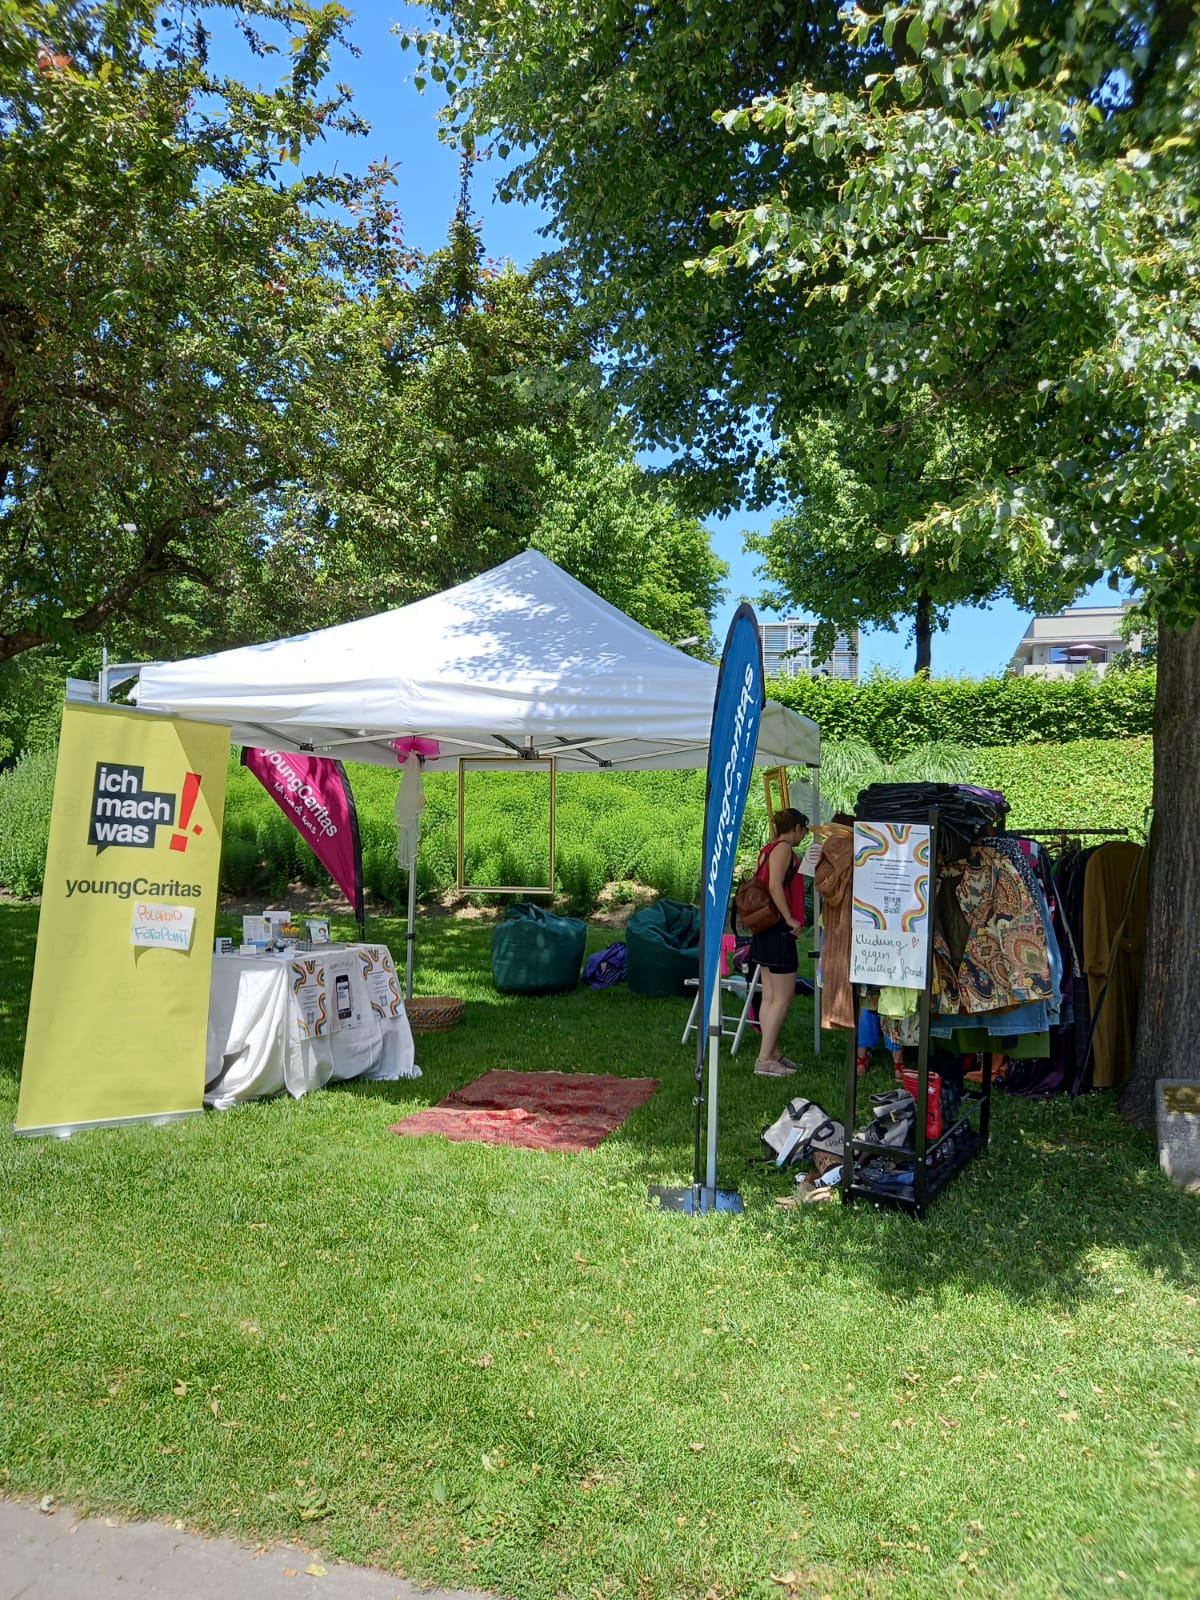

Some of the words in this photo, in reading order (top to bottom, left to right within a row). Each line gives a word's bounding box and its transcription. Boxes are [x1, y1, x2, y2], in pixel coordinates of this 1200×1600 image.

[99, 767, 138, 793] ich
[707, 663, 754, 905] youngCaritas
[260, 749, 338, 837] youngCaritas
[96, 797, 171, 821] mach
[95, 822, 150, 844] was
[65, 878, 202, 899] youngCaritas
[855, 933, 909, 956] Kleidung
